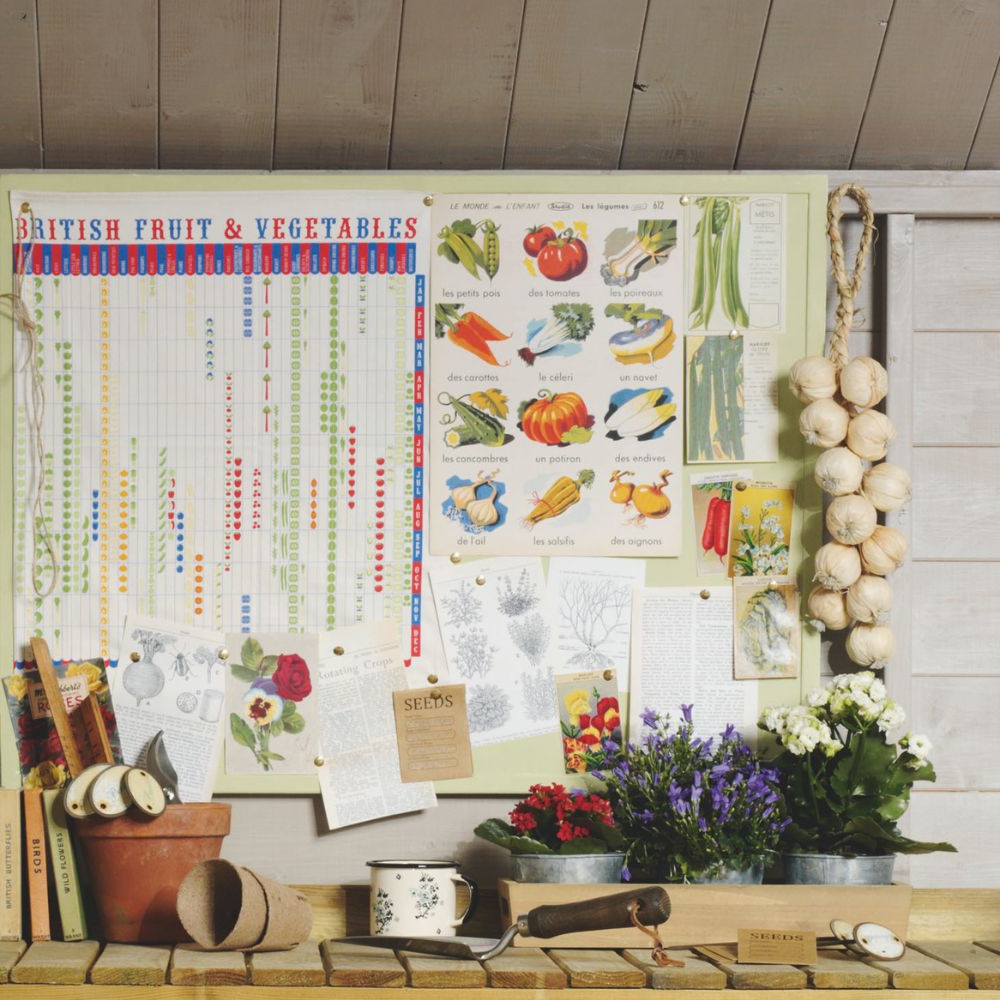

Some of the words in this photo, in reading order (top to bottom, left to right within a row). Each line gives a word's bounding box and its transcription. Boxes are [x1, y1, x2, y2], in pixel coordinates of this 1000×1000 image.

[16, 218, 120, 240] BRITISH
[135, 218, 212, 240] FRUIT
[224, 218, 242, 240] &
[255, 217, 418, 240] VEGETABLES
[442, 288, 454, 298] les
[457, 288, 480, 300] petits
[483, 289, 501, 300] pois
[528, 288, 544, 297] des
[546, 289, 580, 298] tomates
[610, 288, 622, 297] les
[624, 289, 663, 299] poireaux
[448, 373, 462, 382] des
[464, 374, 499, 382] carottes
[539, 373, 547, 382] le
[549, 373, 574, 382] céleri
[632, 374, 658, 382] navet
[442, 454, 455, 463] les
[458, 454, 508, 463] concombres
[548, 455, 581, 465] potiron
[615, 454, 630, 463] des
[633, 454, 666, 463] endives
[457, 536, 467, 546] de
[469, 536, 486, 546] l'ail
[533, 536, 546, 546] les
[549, 536, 575, 546] salsifis
[610, 536, 626, 546] des
[628, 538, 662, 548] oignons
[319, 664, 359, 680] Rotating
[363, 657, 393, 670] Crops
[38, 696, 82, 712] ROES
[404, 695, 453, 711] SEEDS
[56, 832, 67, 870] FLOWERS
[32, 839, 42, 874] BIRDS
[62, 872, 71, 894] WILD
[750, 932, 804, 941] SEEDS
